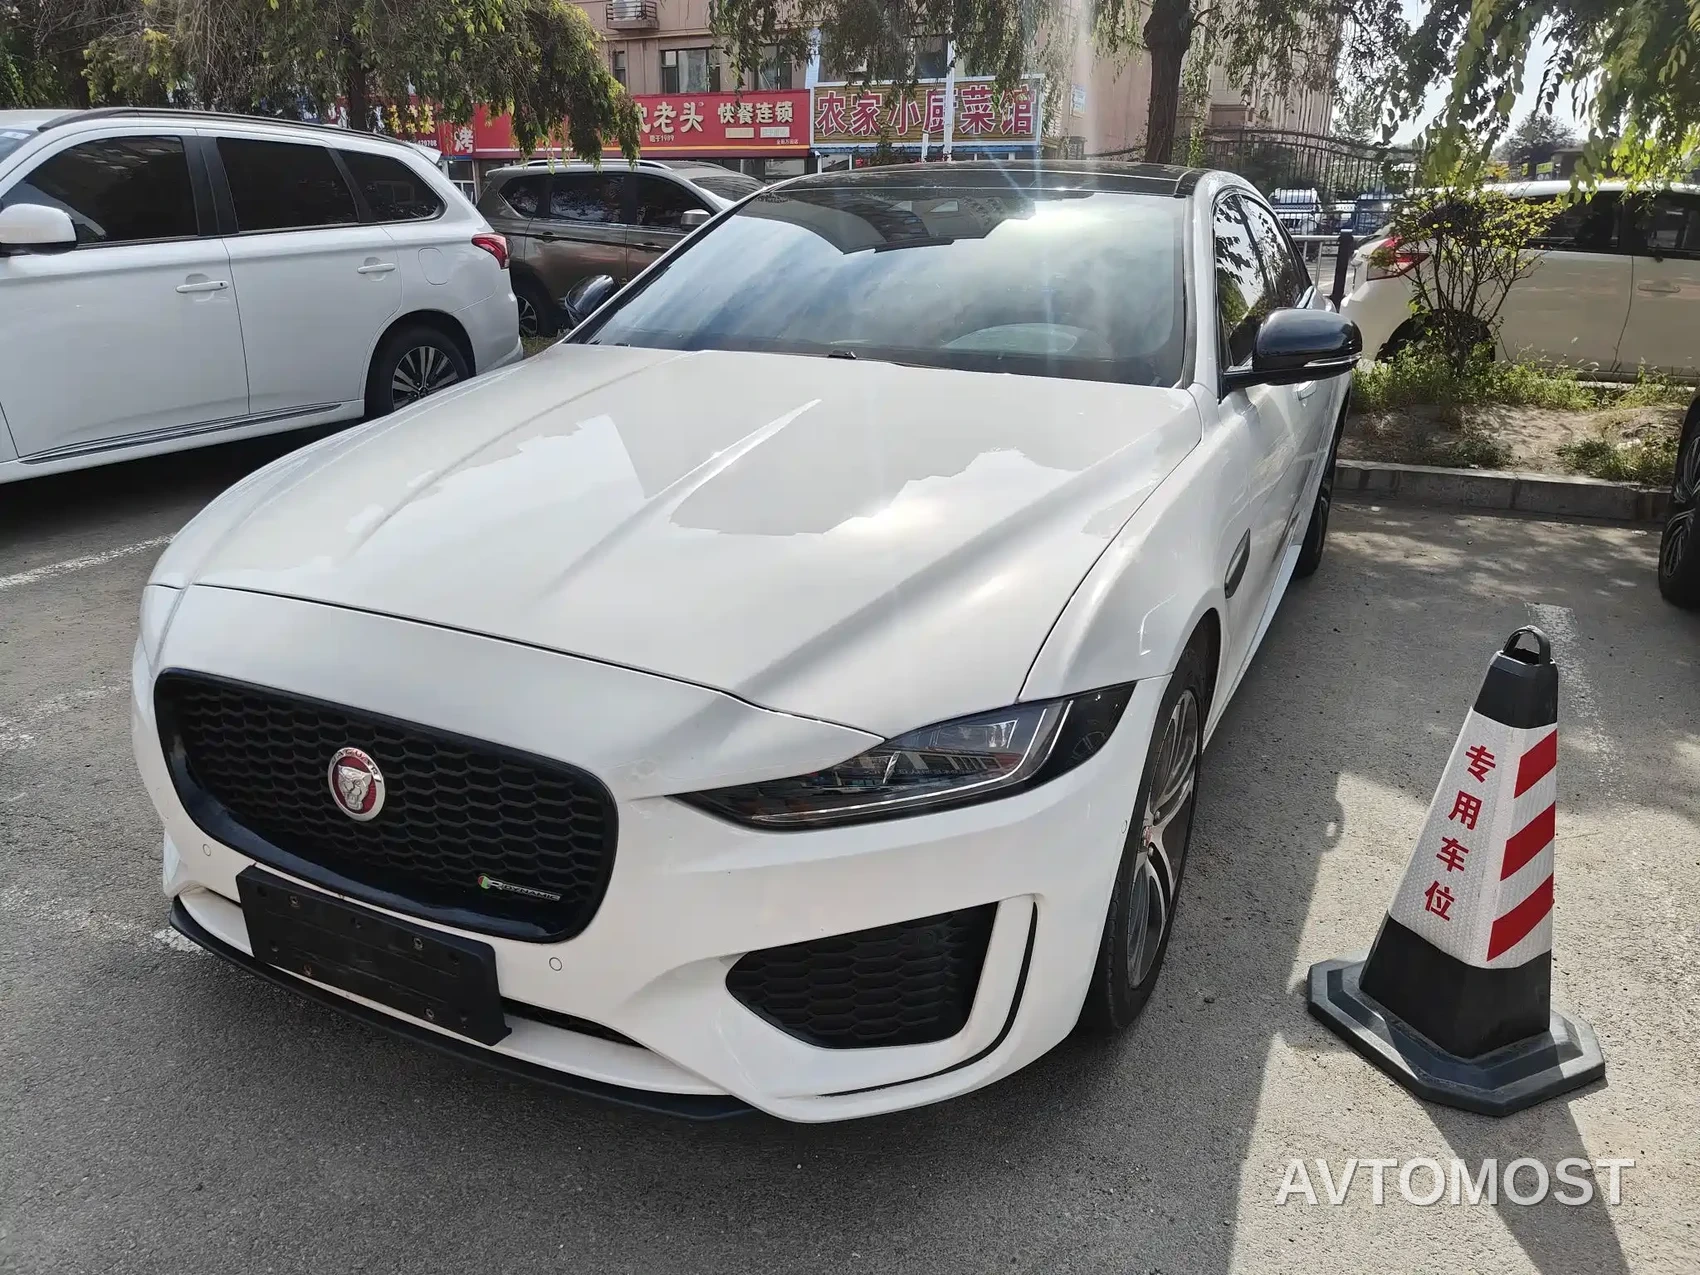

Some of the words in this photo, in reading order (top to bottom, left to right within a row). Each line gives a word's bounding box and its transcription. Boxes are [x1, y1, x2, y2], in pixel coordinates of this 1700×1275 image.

[717, 100, 794, 125] 快餐连锁
[815, 84, 1038, 137] 农家小厨菜馆
[331, 748, 378, 775] JAGUAR
[1424, 744, 1496, 922] 专用车位
